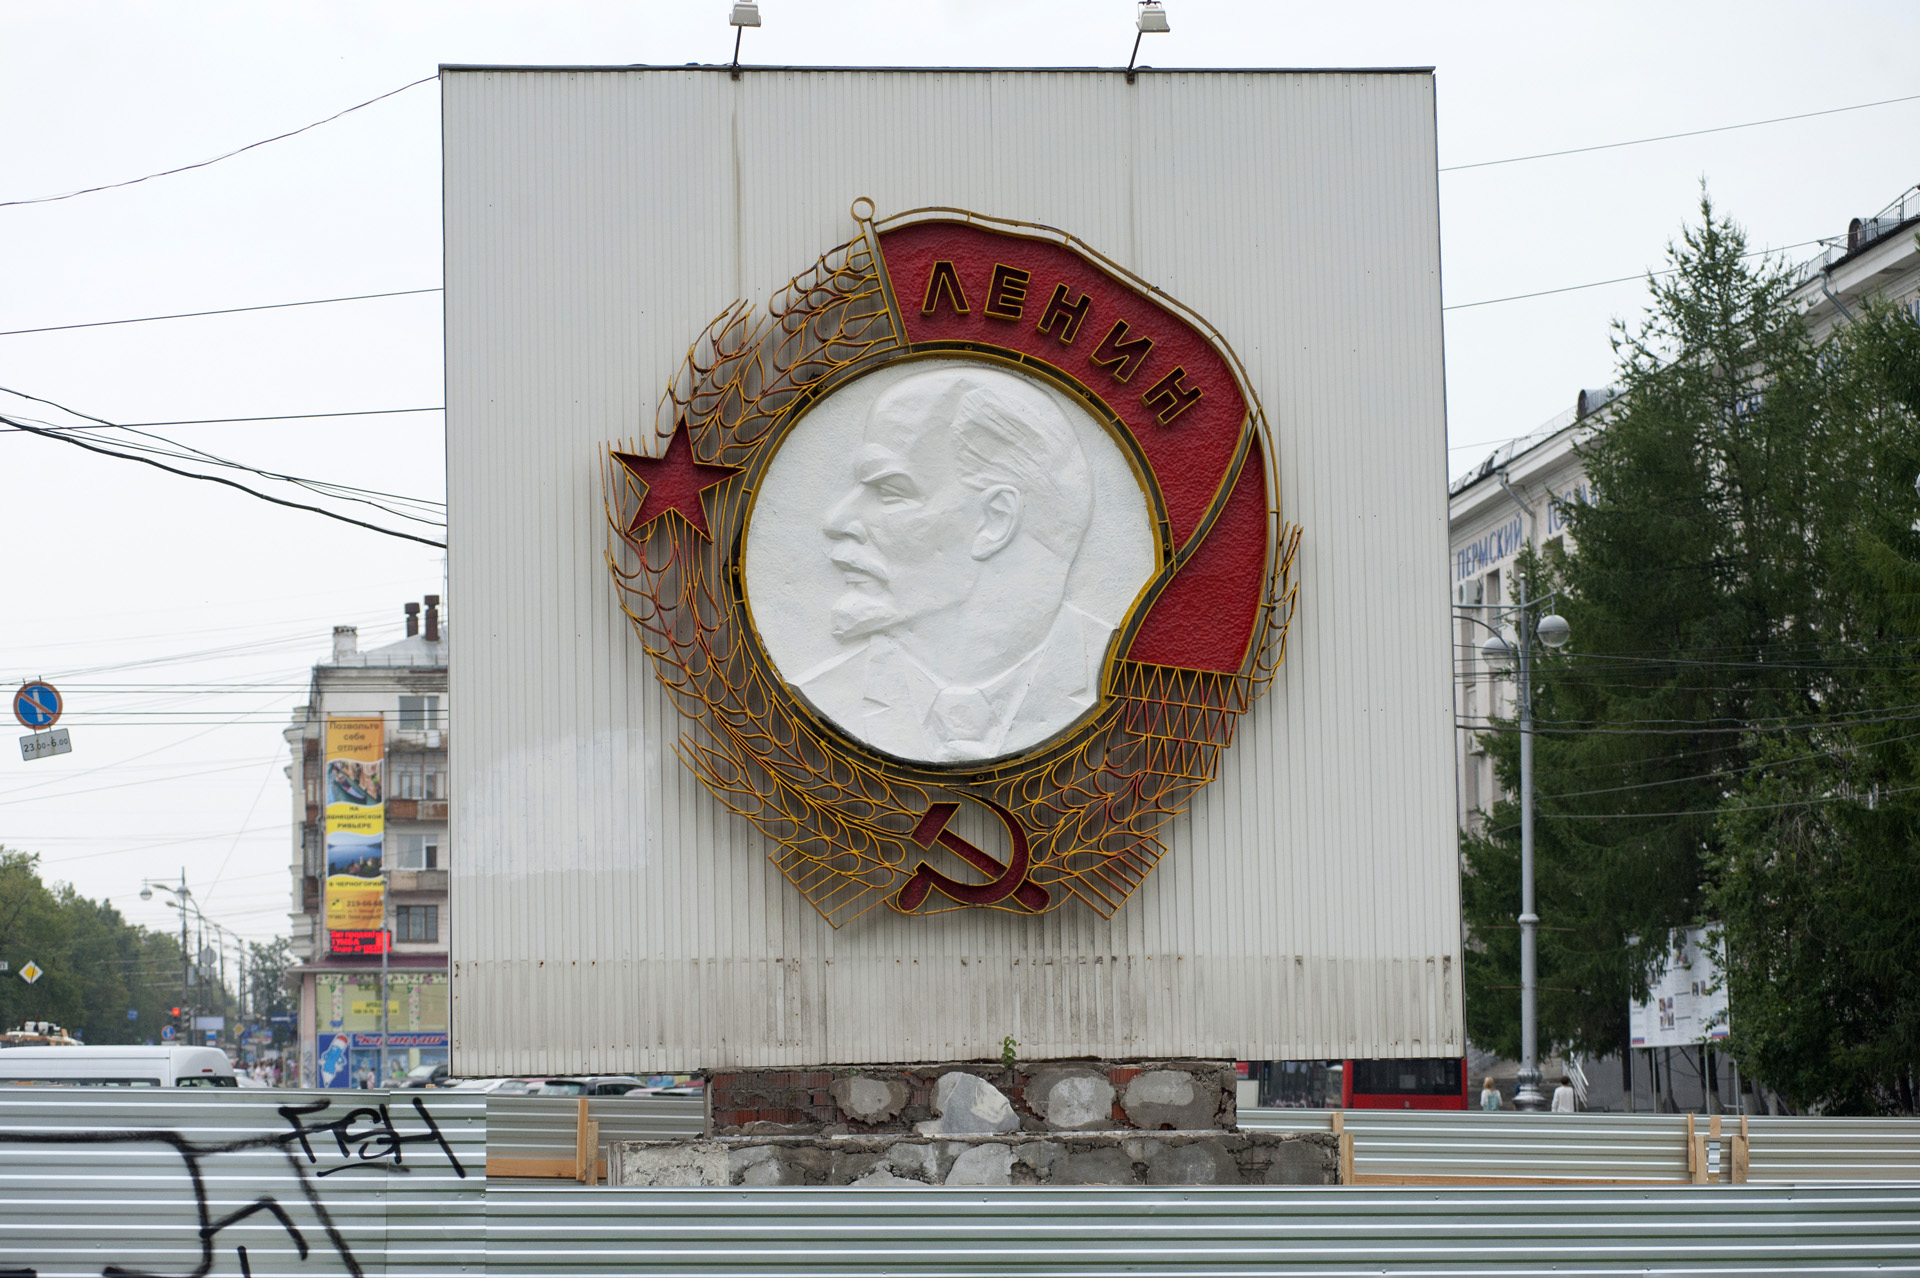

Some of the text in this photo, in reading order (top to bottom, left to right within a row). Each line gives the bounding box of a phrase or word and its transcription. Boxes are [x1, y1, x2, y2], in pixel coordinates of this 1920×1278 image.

[921, 260, 1203, 425] ЛЕНИН
[1457, 511, 1523, 581] ПЕРМСКИЙ
[343, 732, 367, 740] себе
